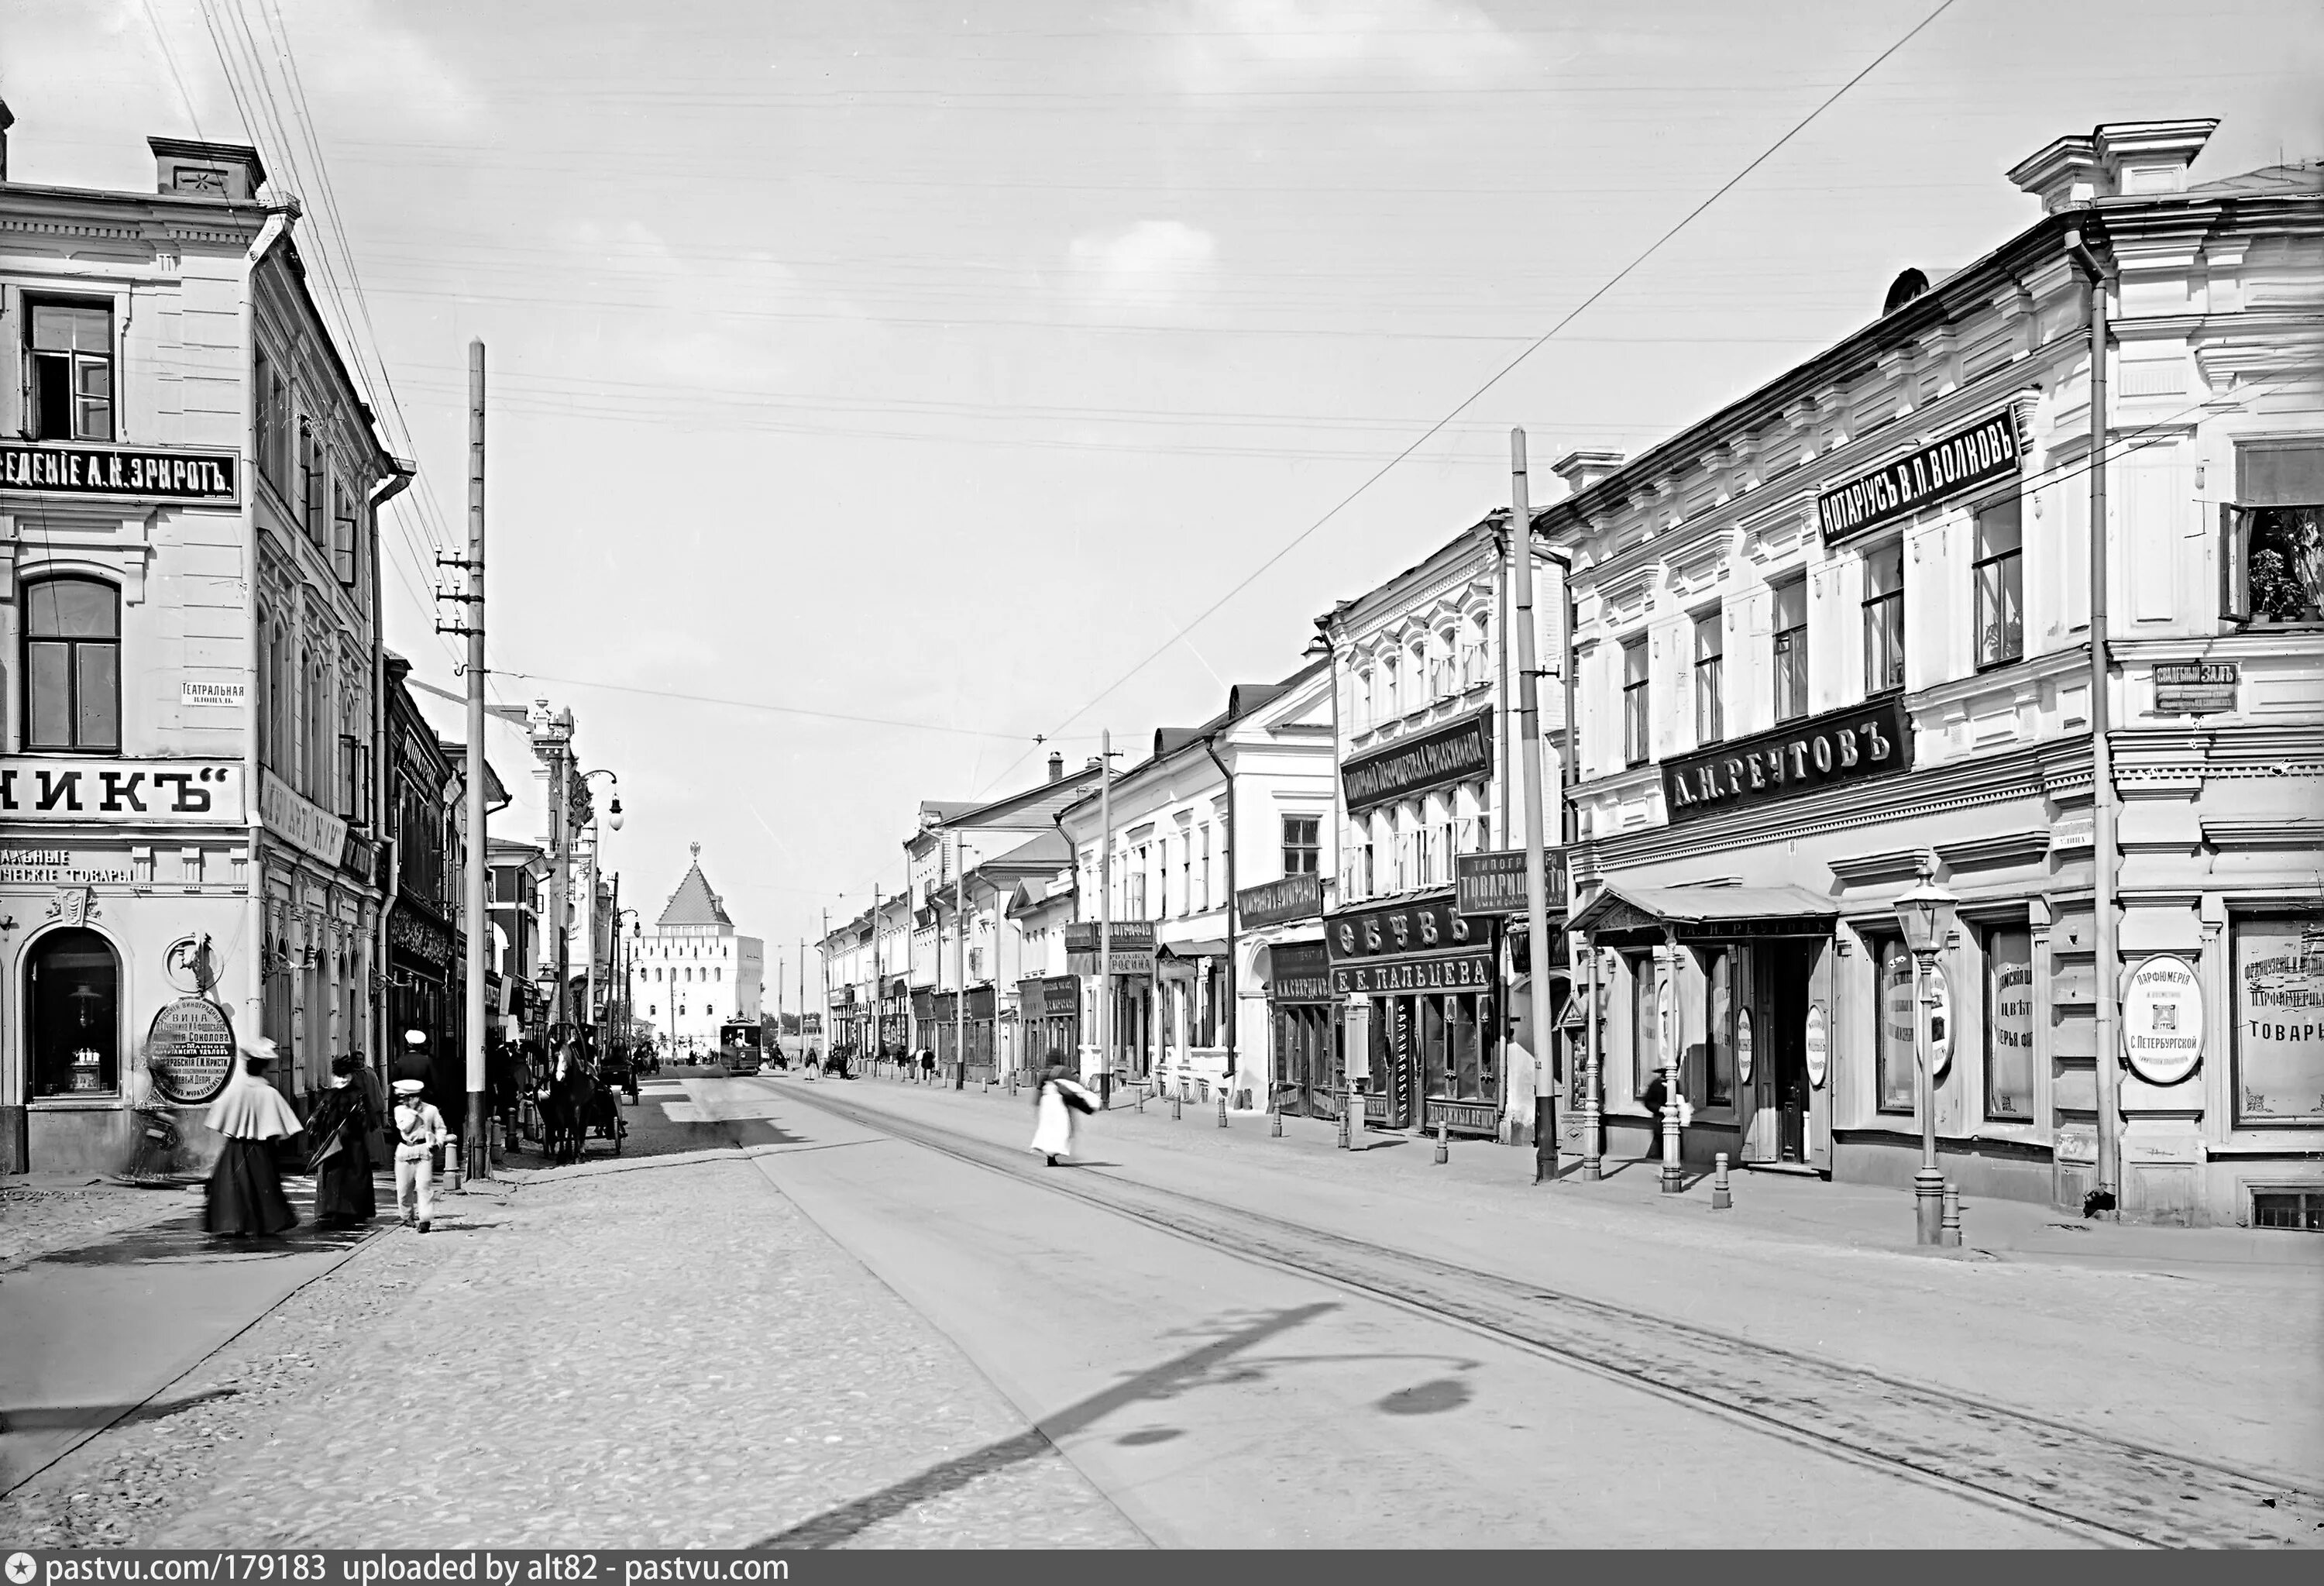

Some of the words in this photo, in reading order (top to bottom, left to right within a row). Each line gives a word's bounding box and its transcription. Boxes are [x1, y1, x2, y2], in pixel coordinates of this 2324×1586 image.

[0, 451, 81, 486] ЕДЕНІЕ
[2157, 666, 2200, 683] СВАДЕБНЫЙ
[2201, 666, 2234, 683] ЗАЛЪ
[182, 683, 244, 697] ТЕАТРАЛЬНАЯ
[1096, 923, 1151, 937] ТПОГРАФІЯ
[1339, 907, 1470, 954] ОБУВЬ
[1375, 960, 1487, 989] ПАЛЬЦЕВА
[2137, 971, 2191, 986] ПАРФЮМЕРІЯ
[2001, 999, 2033, 1017] ЦВѢТ
[173, 1013, 208, 1022] ВИНА
